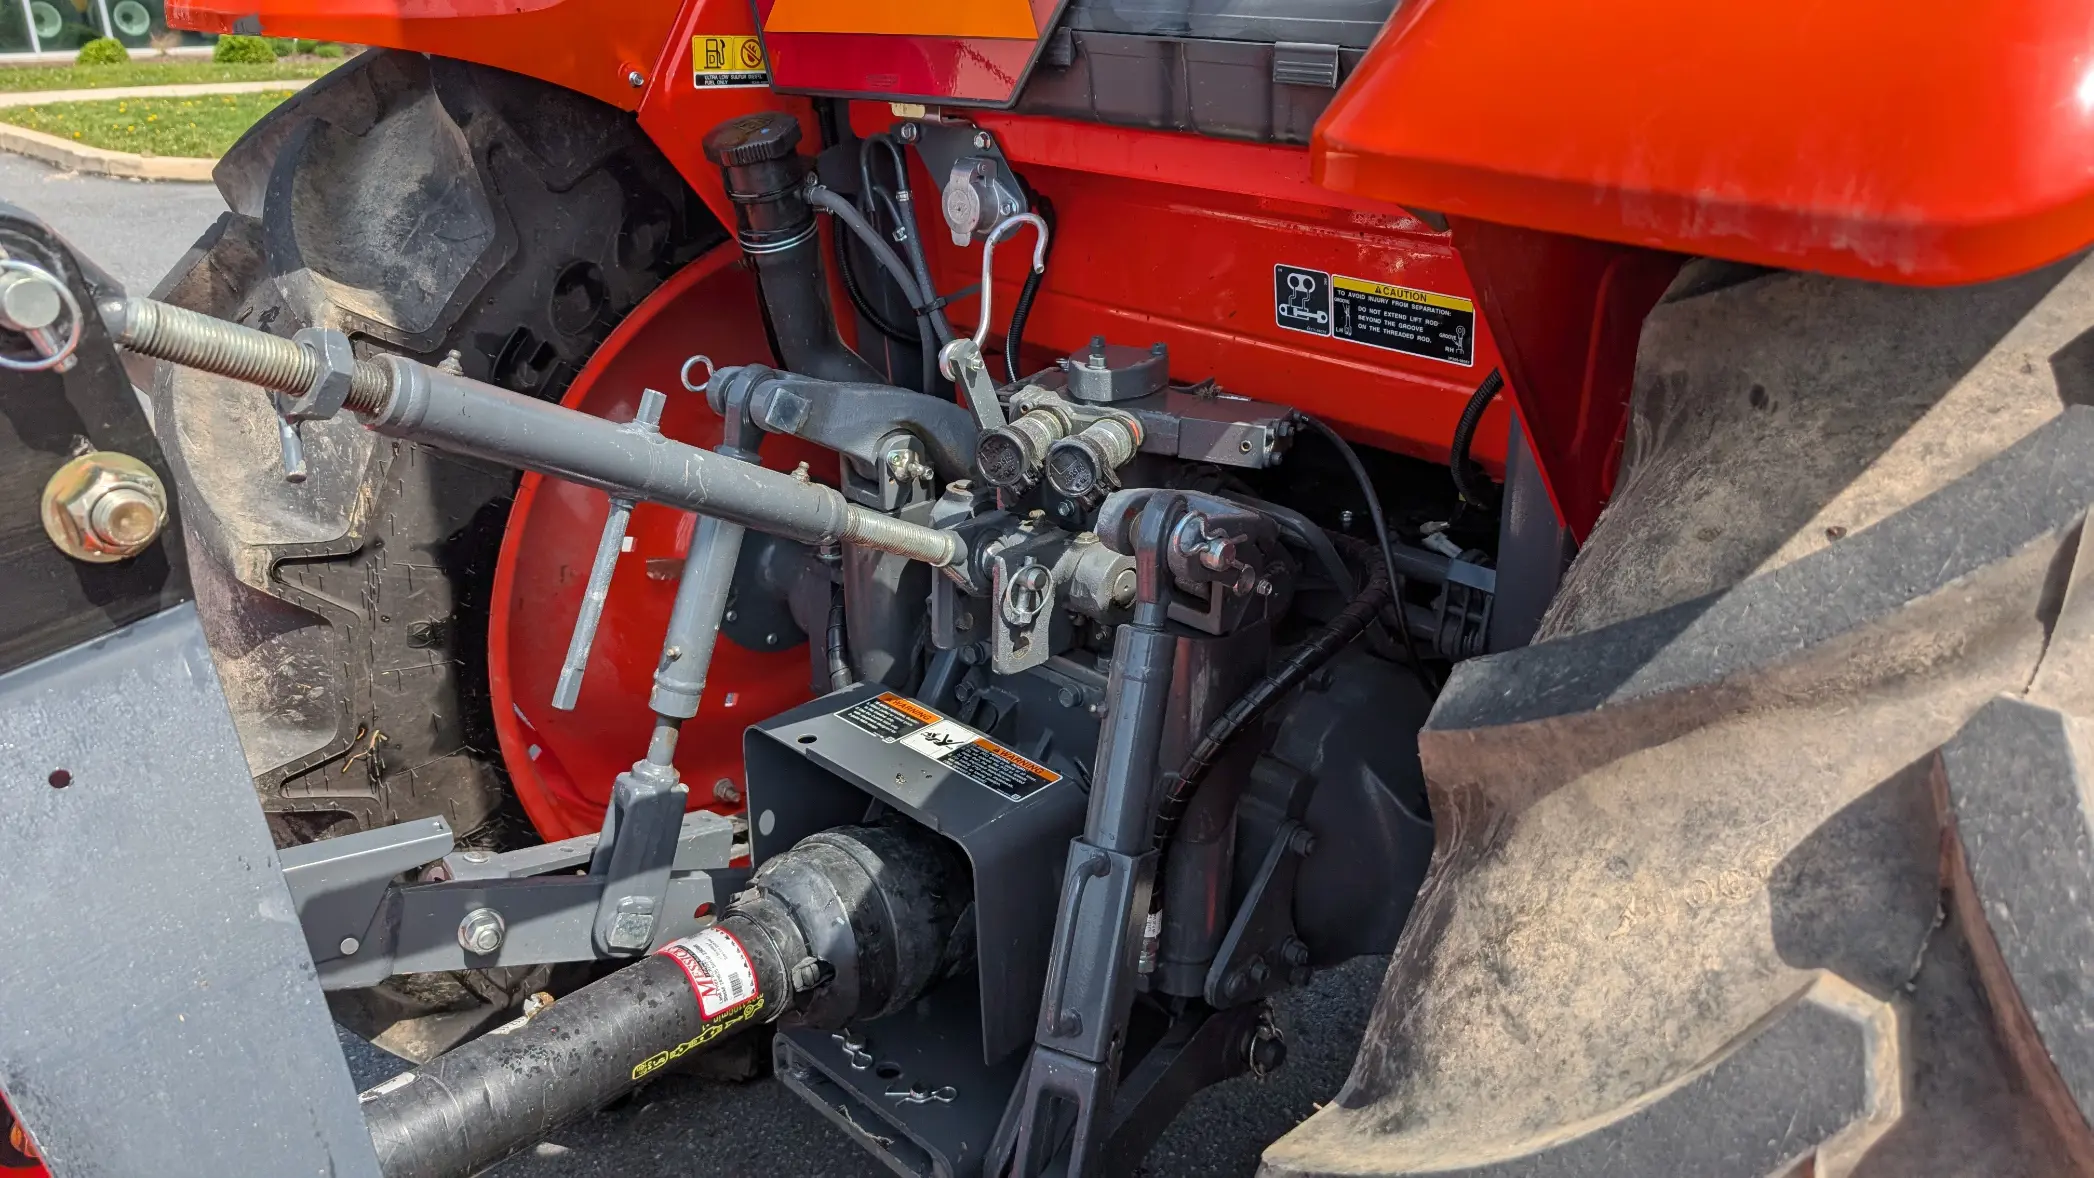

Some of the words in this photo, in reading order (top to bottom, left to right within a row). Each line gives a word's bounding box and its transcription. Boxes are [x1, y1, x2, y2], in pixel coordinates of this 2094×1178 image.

[1383, 286, 1427, 302] CAUTION
[1348, 292, 1366, 300] AVOID
[1368, 296, 1388, 304] INJURY
[1392, 300, 1408, 308] FROM
[1412, 304, 1452, 316] SEPARATION:
[1358, 315, 1382, 324] BEYOND
[1398, 323, 1424, 333] GROOVE
[1384, 311, 1406, 320] EXTEND
[1383, 328, 1414, 340] THREADED
[1416, 335, 1432, 344] ROD.
[1439, 332, 1456, 341] GROOVE
[893, 700, 932, 720] WARNING
[1000, 751, 1045, 774] WARNING
